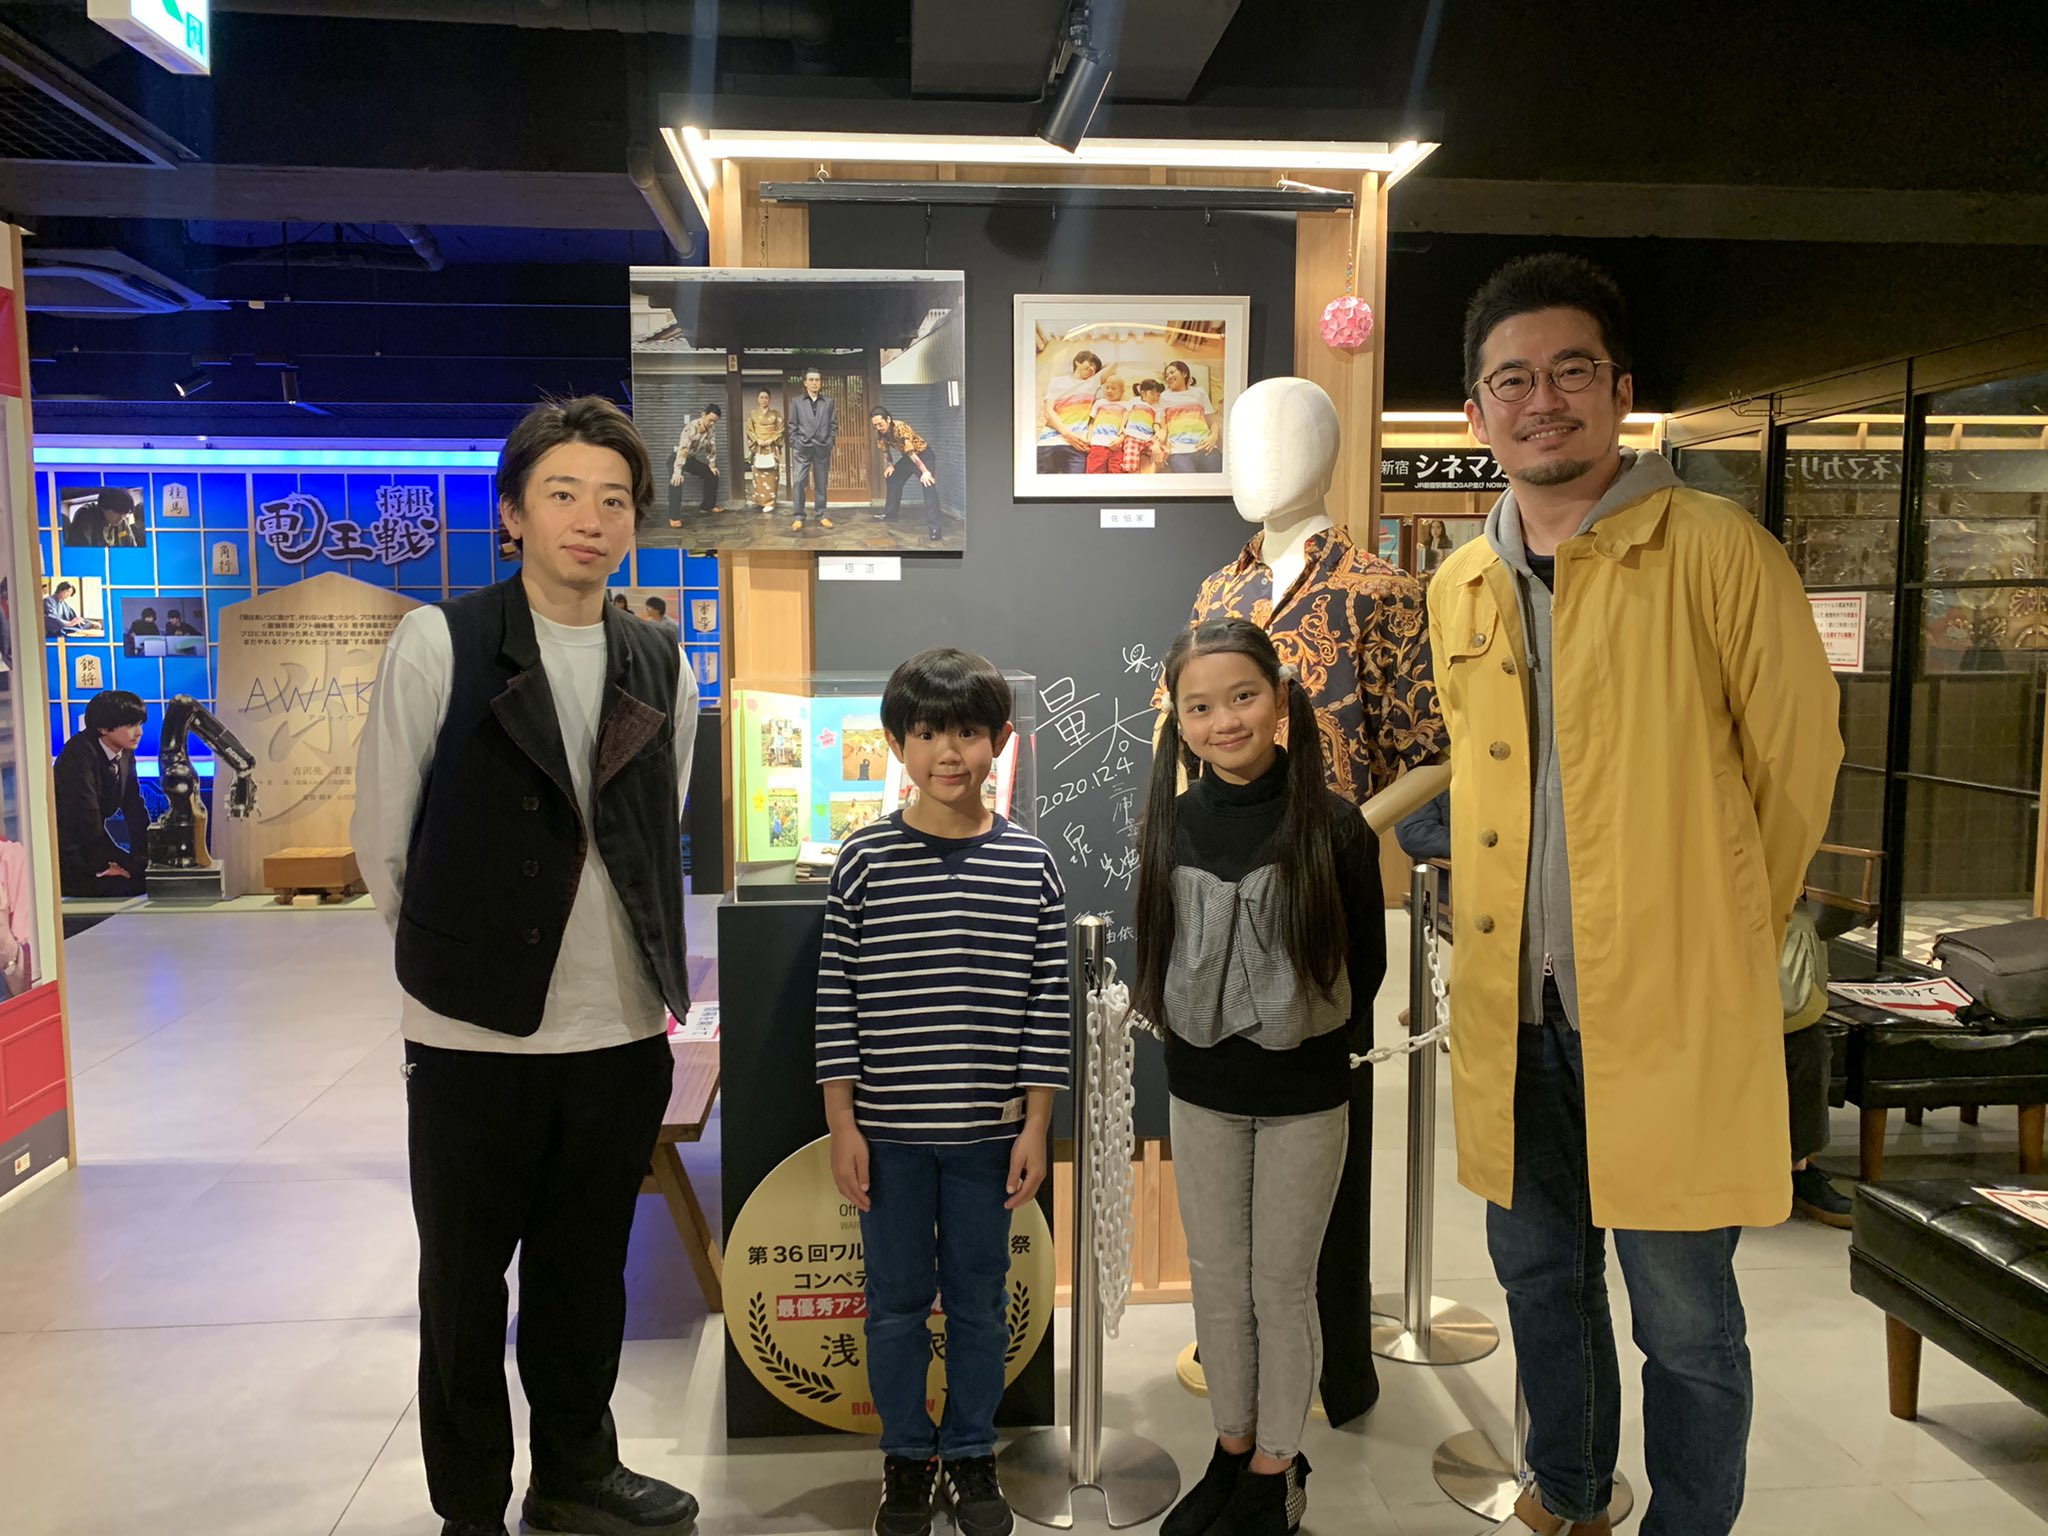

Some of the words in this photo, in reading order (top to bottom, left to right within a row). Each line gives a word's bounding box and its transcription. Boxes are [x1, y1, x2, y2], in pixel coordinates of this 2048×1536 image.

[168, 485, 183, 515] 桂馬
[378, 486, 432, 515] 将棋
[257, 493, 437, 562] 電王戦
[218, 544, 232, 573] 角行
[80, 658, 97, 687] 銀将
[1035, 757, 1135, 818] 2020.12.4
[1011, 1234, 1031, 1253] 祭
[820, 1333, 861, 1368] 浅
